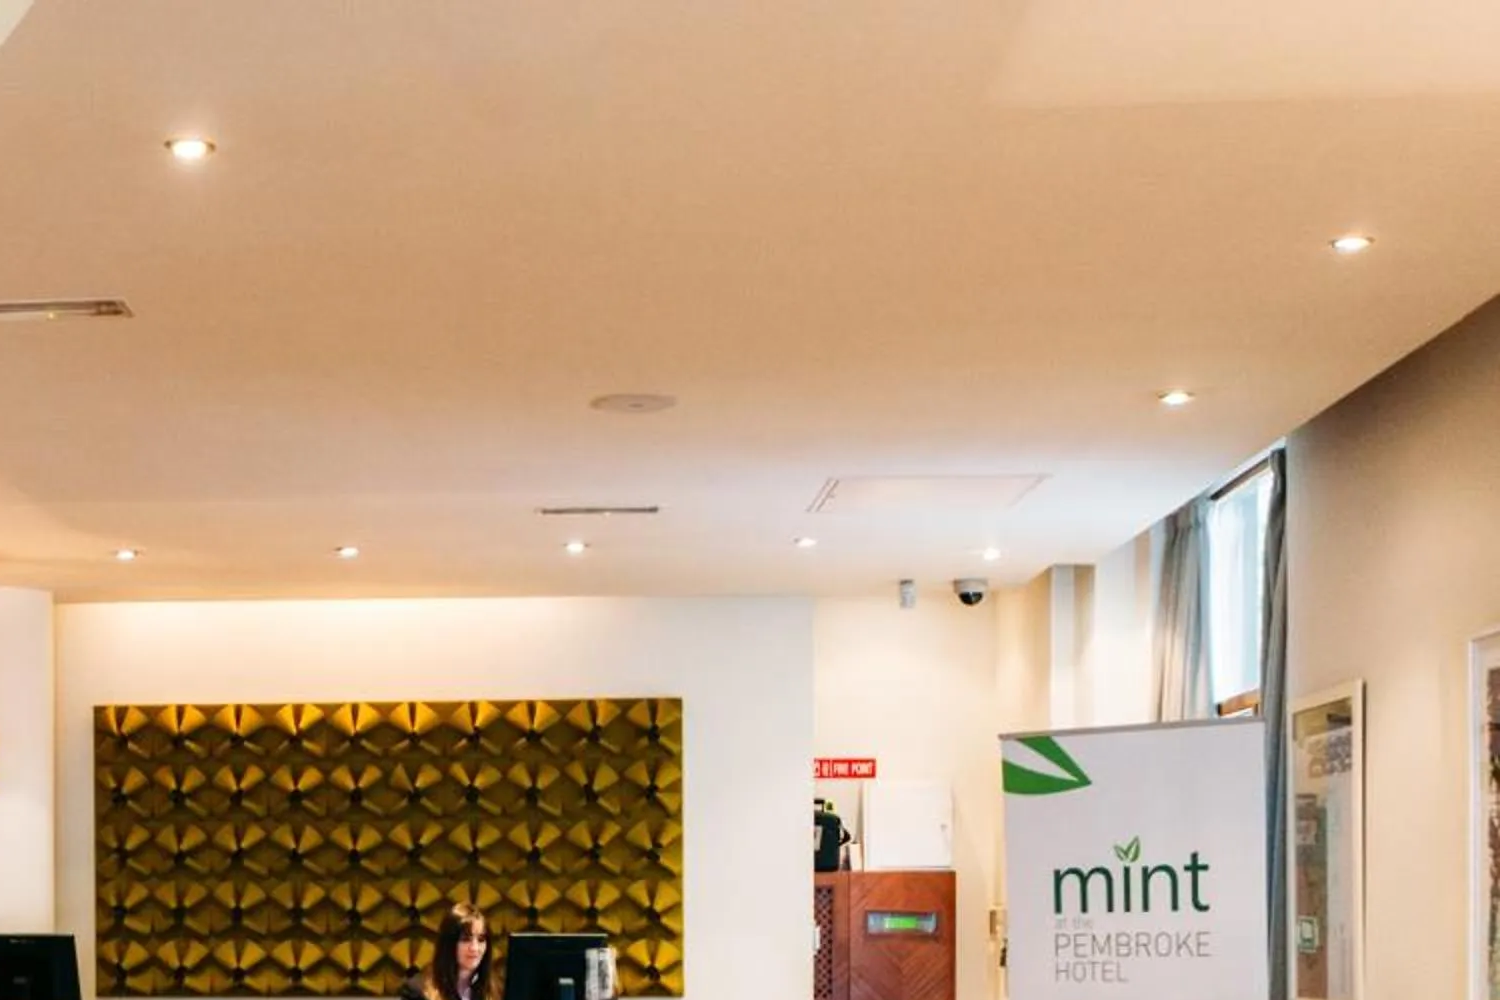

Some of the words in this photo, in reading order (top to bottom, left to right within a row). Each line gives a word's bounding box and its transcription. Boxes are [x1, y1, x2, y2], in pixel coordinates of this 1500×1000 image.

[1053, 850, 1210, 915] mint
[1053, 930, 1212, 959] PEMBROKE
[1054, 960, 1130, 984] HOTEL
